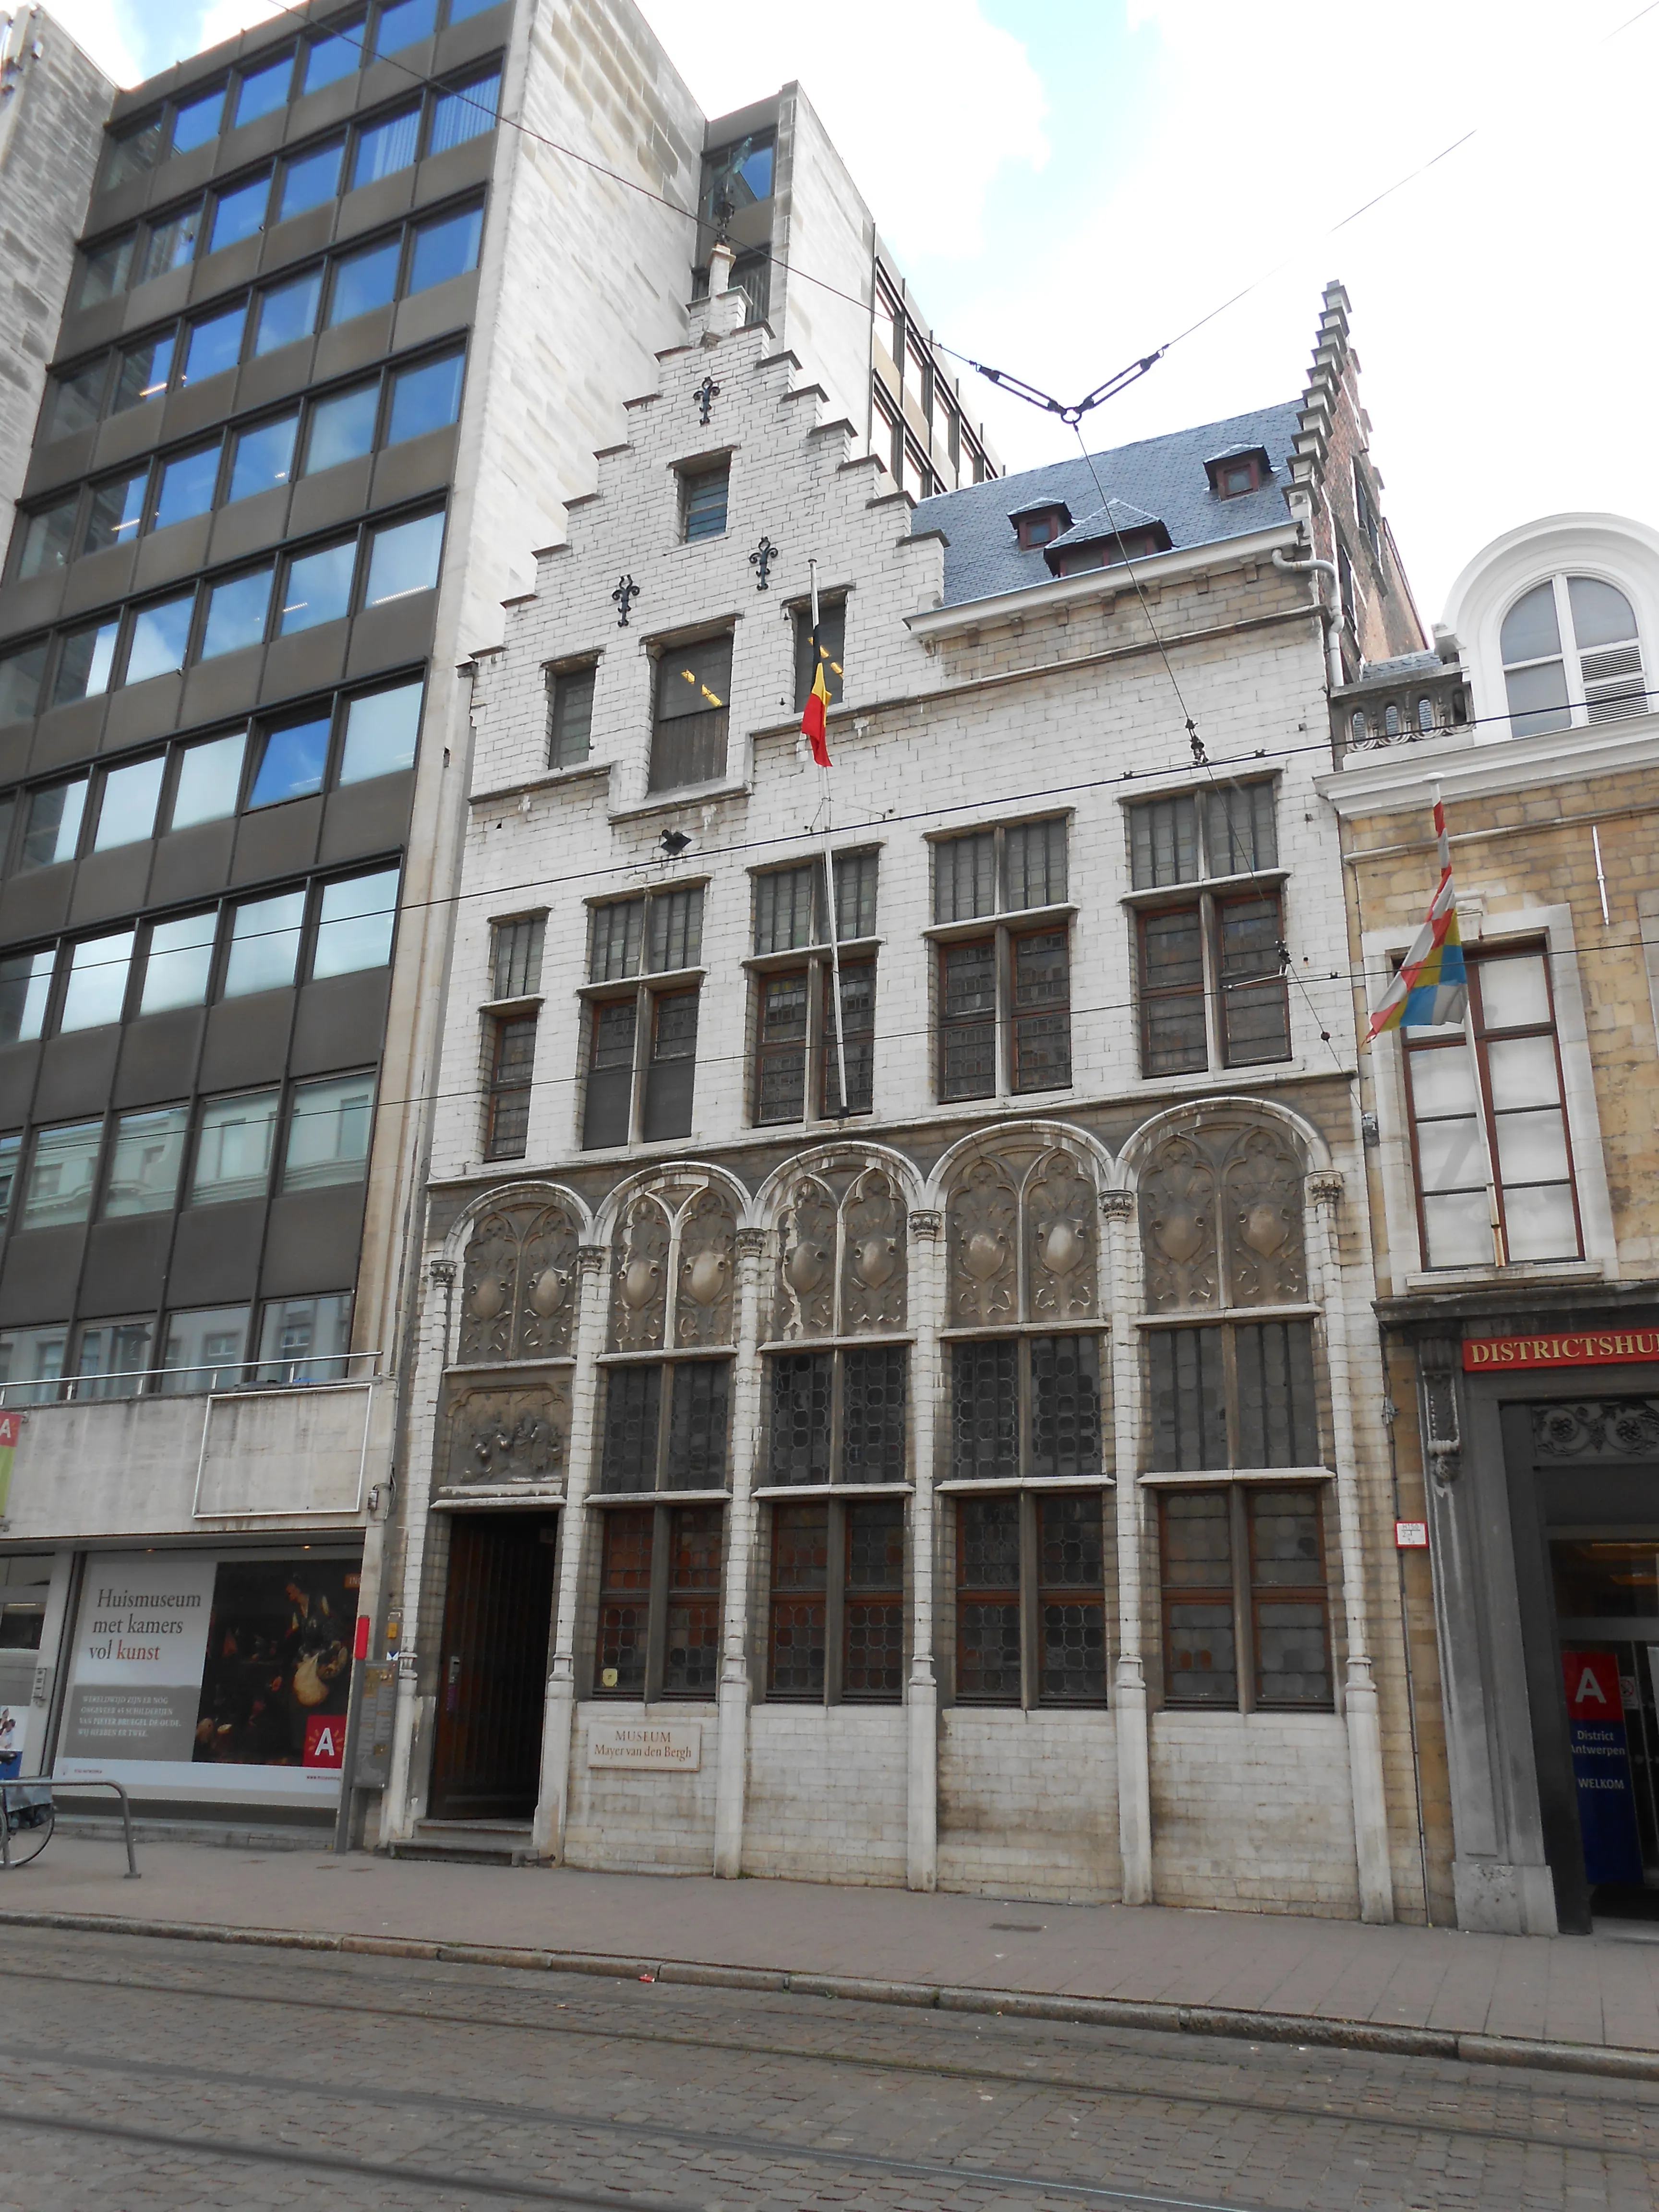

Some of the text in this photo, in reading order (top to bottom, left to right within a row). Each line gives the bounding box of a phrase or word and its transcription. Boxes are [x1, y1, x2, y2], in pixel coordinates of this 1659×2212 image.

[0, 1419, 11, 1438] A
[97, 1588, 201, 1608] Huismuseum
[93, 1613, 183, 1634] met kamers
[89, 1639, 161, 1660] vol kunst
[1575, 1667, 1607, 1704] A
[127, 1696, 142, 1705] ZIJN
[314, 1727, 335, 1756] A
[615, 1731, 671, 1743] MUSEUM
[1577, 1730, 1614, 1741] District
[594, 1744, 691, 1762] Mayer van den Bergh
[1578, 1778, 1624, 1789] WELKOM
